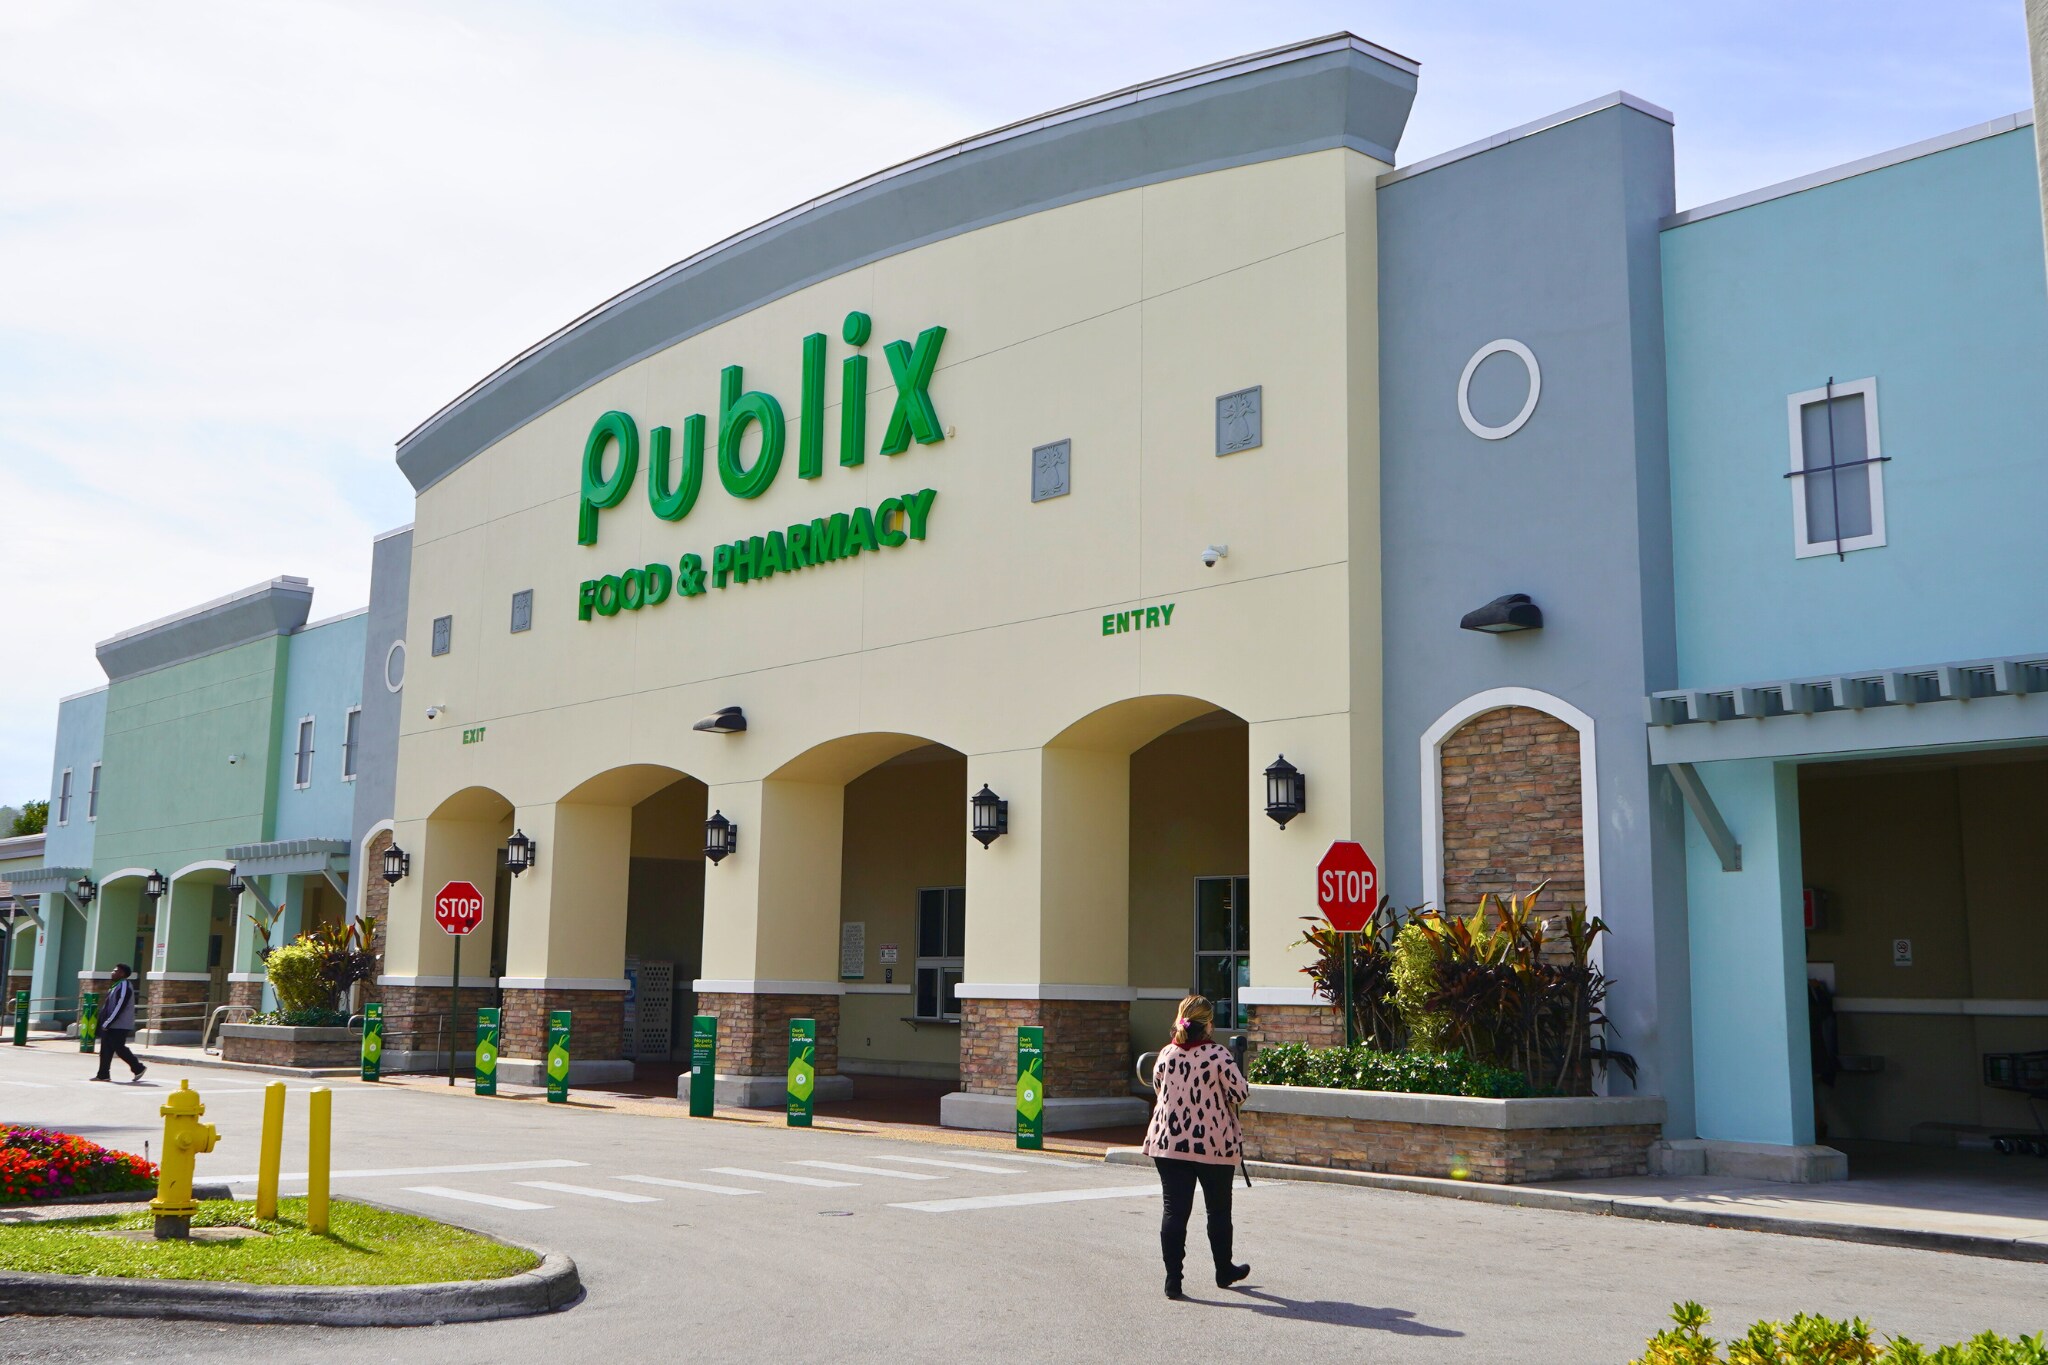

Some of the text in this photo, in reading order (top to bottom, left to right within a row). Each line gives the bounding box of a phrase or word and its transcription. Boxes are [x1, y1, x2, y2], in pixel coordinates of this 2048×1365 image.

[578, 488, 937, 621] FOOD & PHARMACY
[1102, 603, 1175, 636] ENTRY
[463, 727, 486, 745] EXIT
[1321, 869, 1374, 903] STOP
[438, 897, 480, 918] STOP
